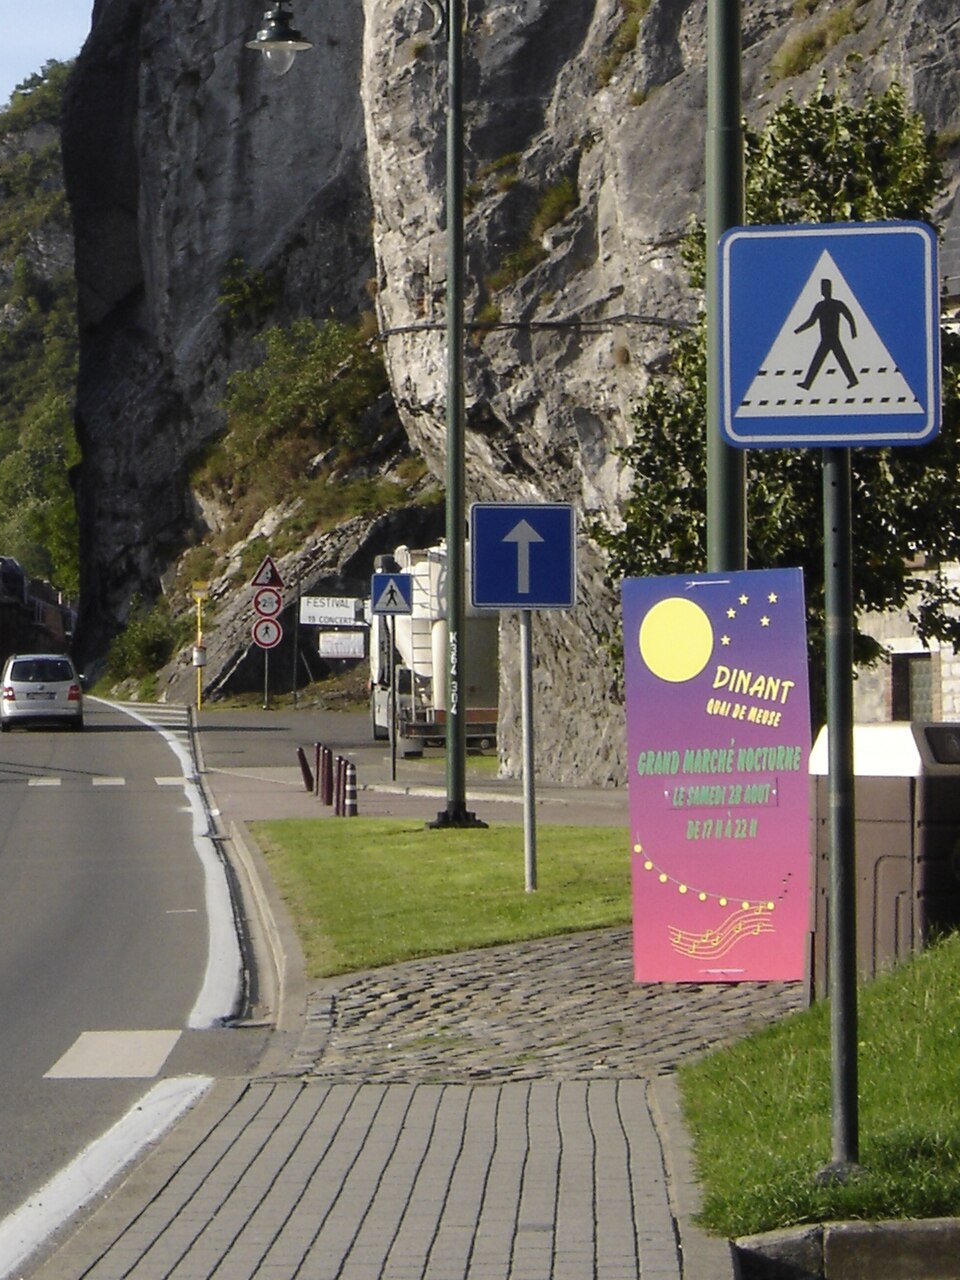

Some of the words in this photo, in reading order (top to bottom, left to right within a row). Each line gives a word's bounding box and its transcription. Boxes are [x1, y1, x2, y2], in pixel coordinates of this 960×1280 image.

[306, 597, 351, 609] FESTIVAL
[712, 665, 795, 704] DINANT
[706, 698, 732, 717] QUAI
[732, 703, 747, 720] DE
[747, 706, 782, 728] MEUSE
[637, 750, 680, 776] GRAND
[682, 737, 735, 774] MARCHÉ
[736, 745, 802, 772] NOCTURNE
[673, 786, 685, 807] LE
[687, 785, 726, 806] SAMEDI
[743, 783, 771, 804] AOUT
[687, 819, 700, 840] DE
[734, 818, 748, 839] 22
